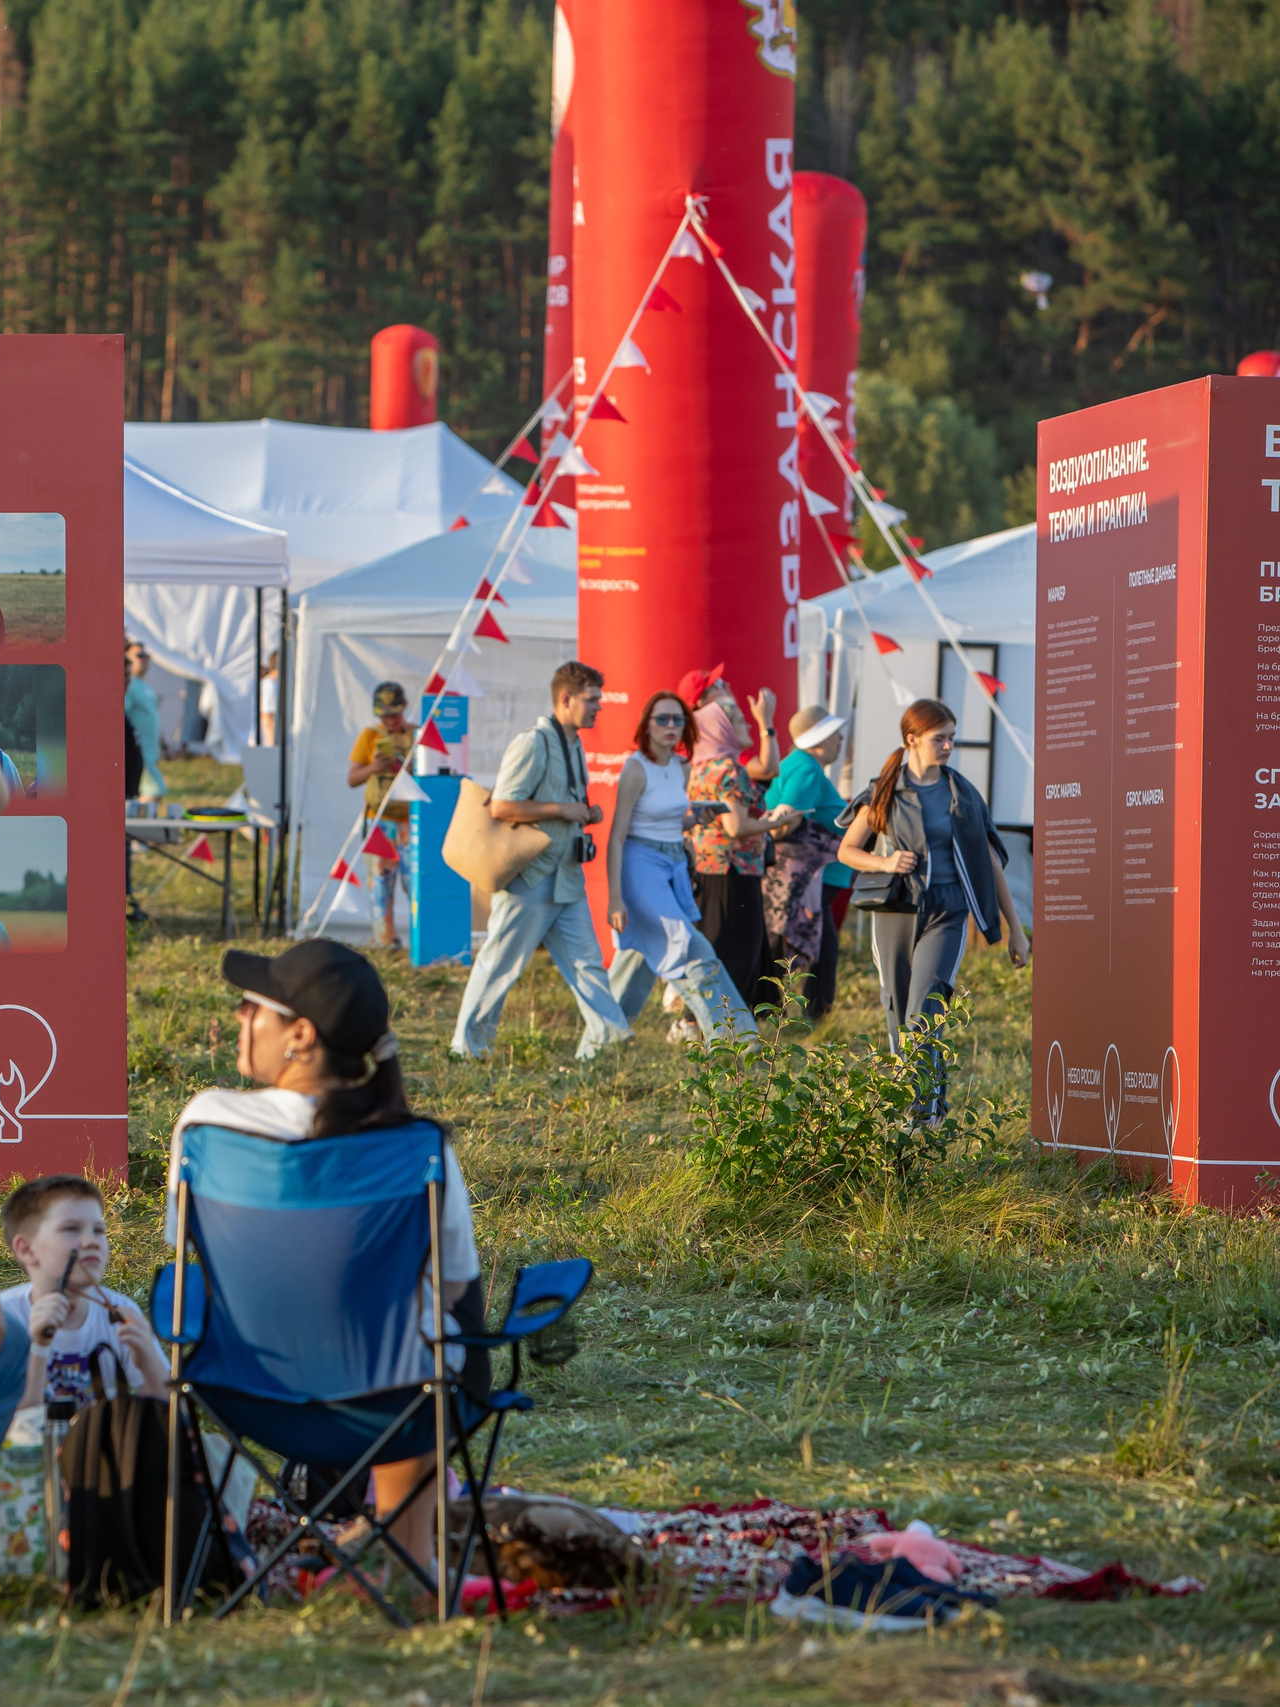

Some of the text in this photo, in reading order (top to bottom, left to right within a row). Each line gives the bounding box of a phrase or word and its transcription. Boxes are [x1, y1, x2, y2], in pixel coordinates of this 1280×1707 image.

[1049, 438, 1150, 495] ВОЗДУХОПЛАВАНИЕ.
[1048, 490, 1148, 543] ТЕОРИЯ И ПРАКТИКА
[1257, 662, 1270, 671] На
[1256, 683, 1272, 692] Эта
[1255, 711, 1269, 720] На
[1253, 869, 1270, 878] Как
[1252, 881, 1280, 889] неско
[1067, 1067, 1100, 1086] НЕБО РОССИИ
[1124, 1072, 1158, 1090] НЕБО РОССИИ
